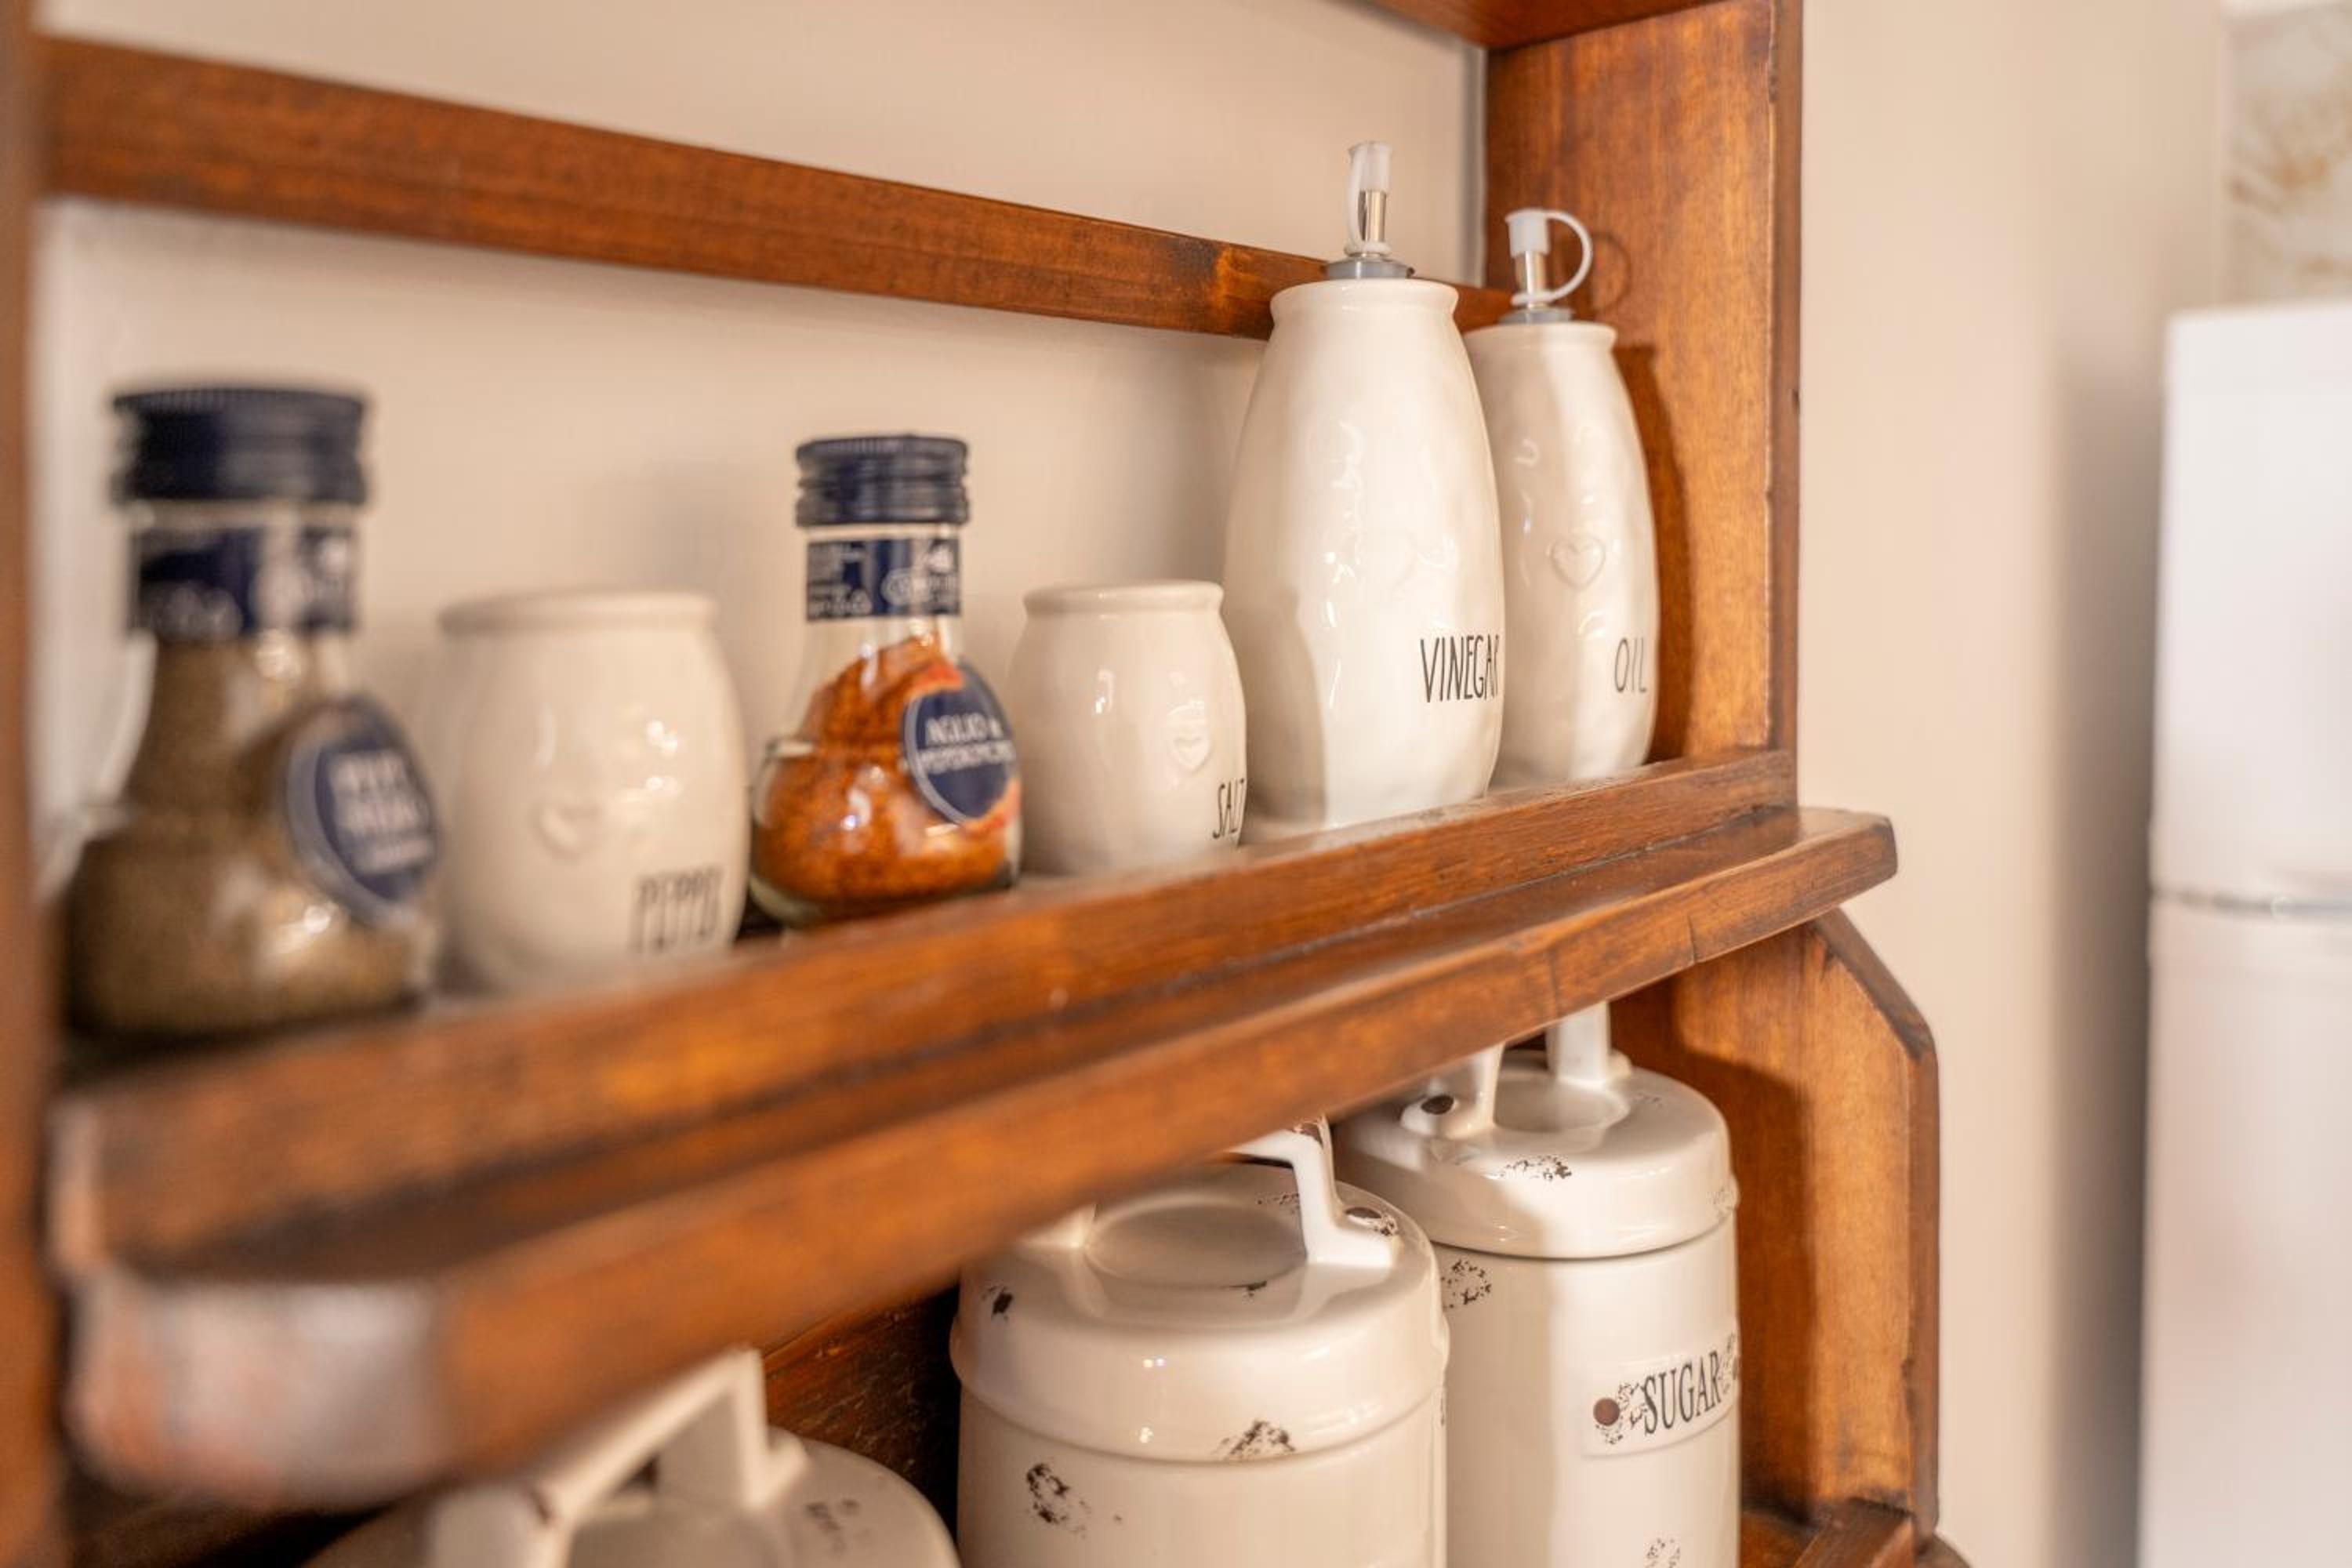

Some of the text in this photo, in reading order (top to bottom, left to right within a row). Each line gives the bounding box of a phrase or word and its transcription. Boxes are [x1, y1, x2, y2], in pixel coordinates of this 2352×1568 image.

[1613, 637, 1647, 693] OIL
[1212, 777, 1244, 840] SALT
[1642, 1349, 1722, 1436] SUGAR
